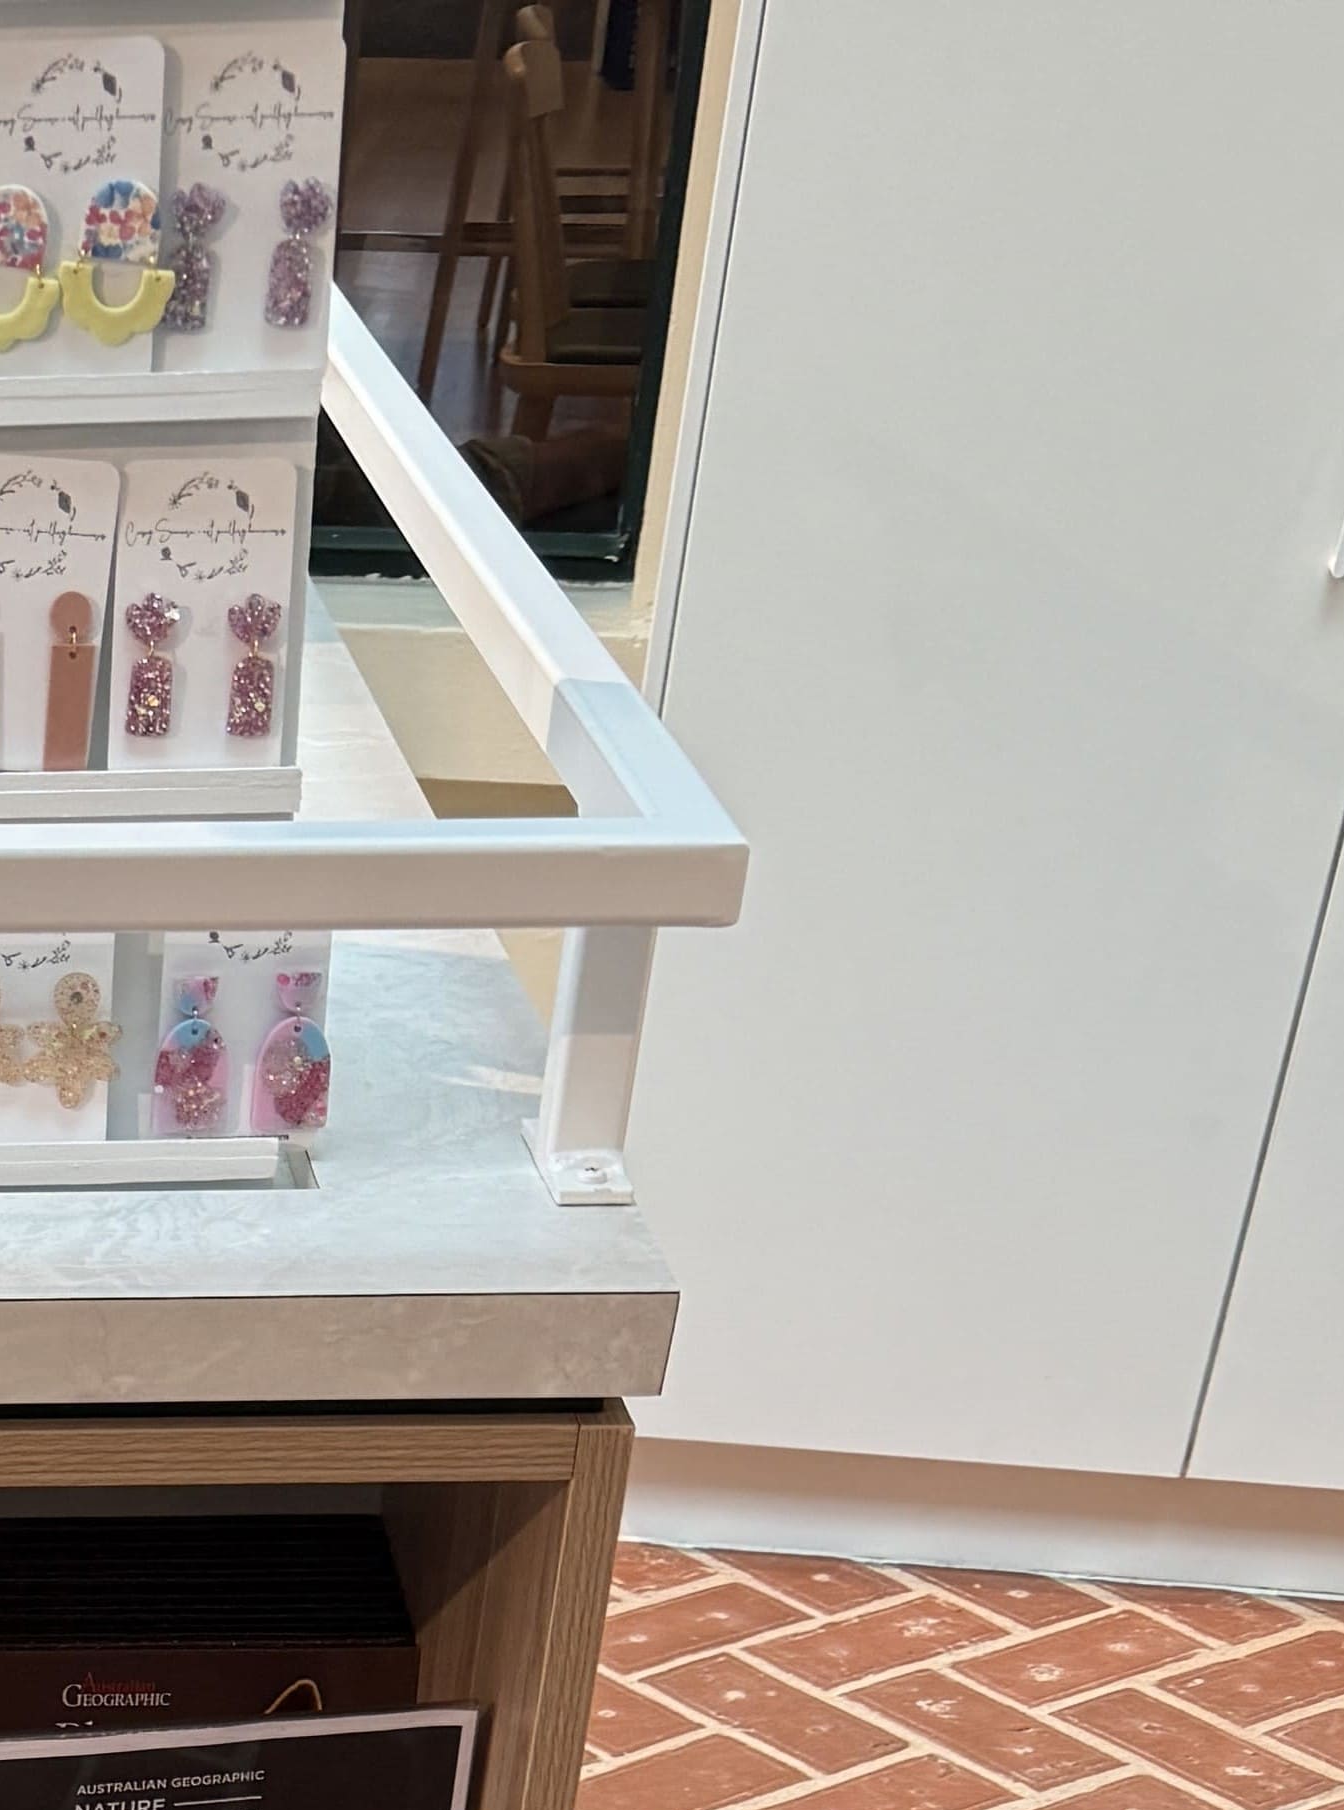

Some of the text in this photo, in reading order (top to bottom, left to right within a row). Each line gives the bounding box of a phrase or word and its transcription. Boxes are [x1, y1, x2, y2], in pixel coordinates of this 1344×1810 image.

[62, 1683, 171, 1707] GEOGRAPHIC
[77, 1770, 265, 1796] AUSTRALIAN GEOGRAPHIC
